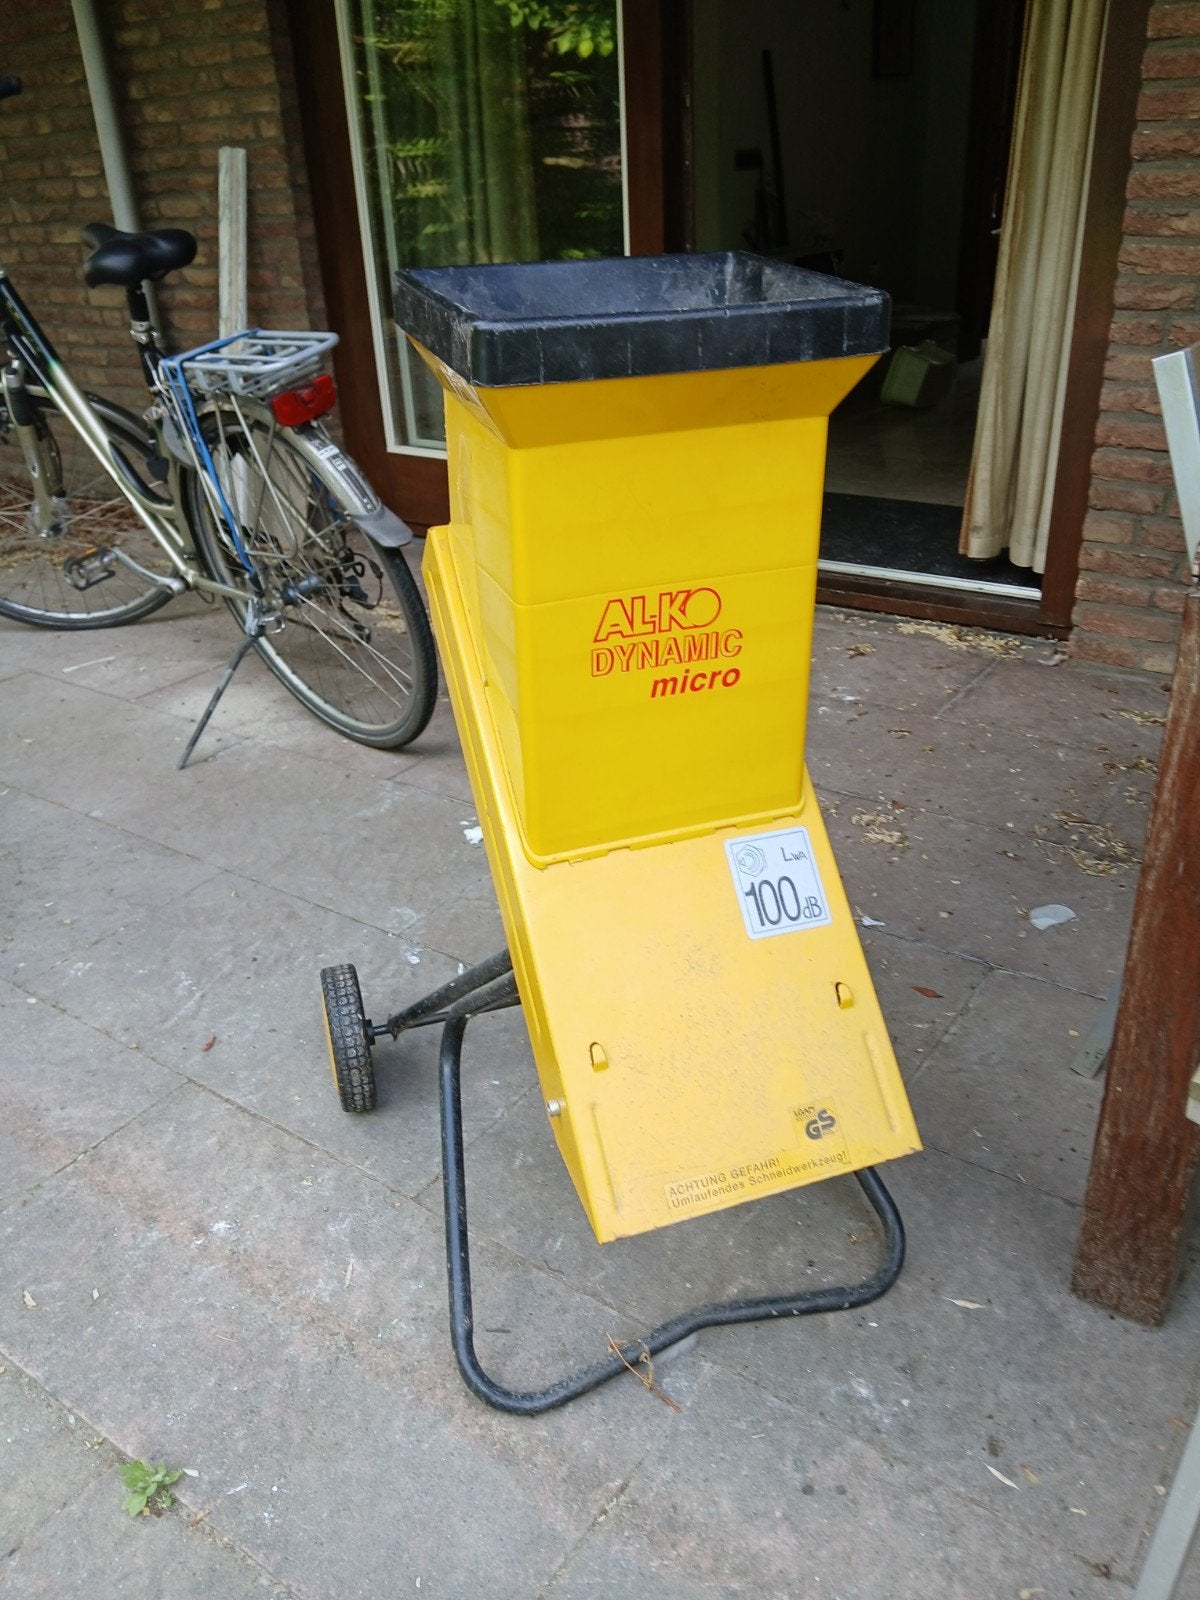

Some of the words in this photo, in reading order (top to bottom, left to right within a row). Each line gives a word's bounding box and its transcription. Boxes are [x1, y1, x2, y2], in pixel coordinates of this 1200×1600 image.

[591, 629, 743, 677] DYNAMIC
[650, 667, 741, 698] micro
[805, 1108, 836, 1140] GS
[669, 1173, 727, 1197] ACHTUNG
[730, 1157, 781, 1178] GEFAHR!
[671, 1181, 746, 1208] Umlaufendes
